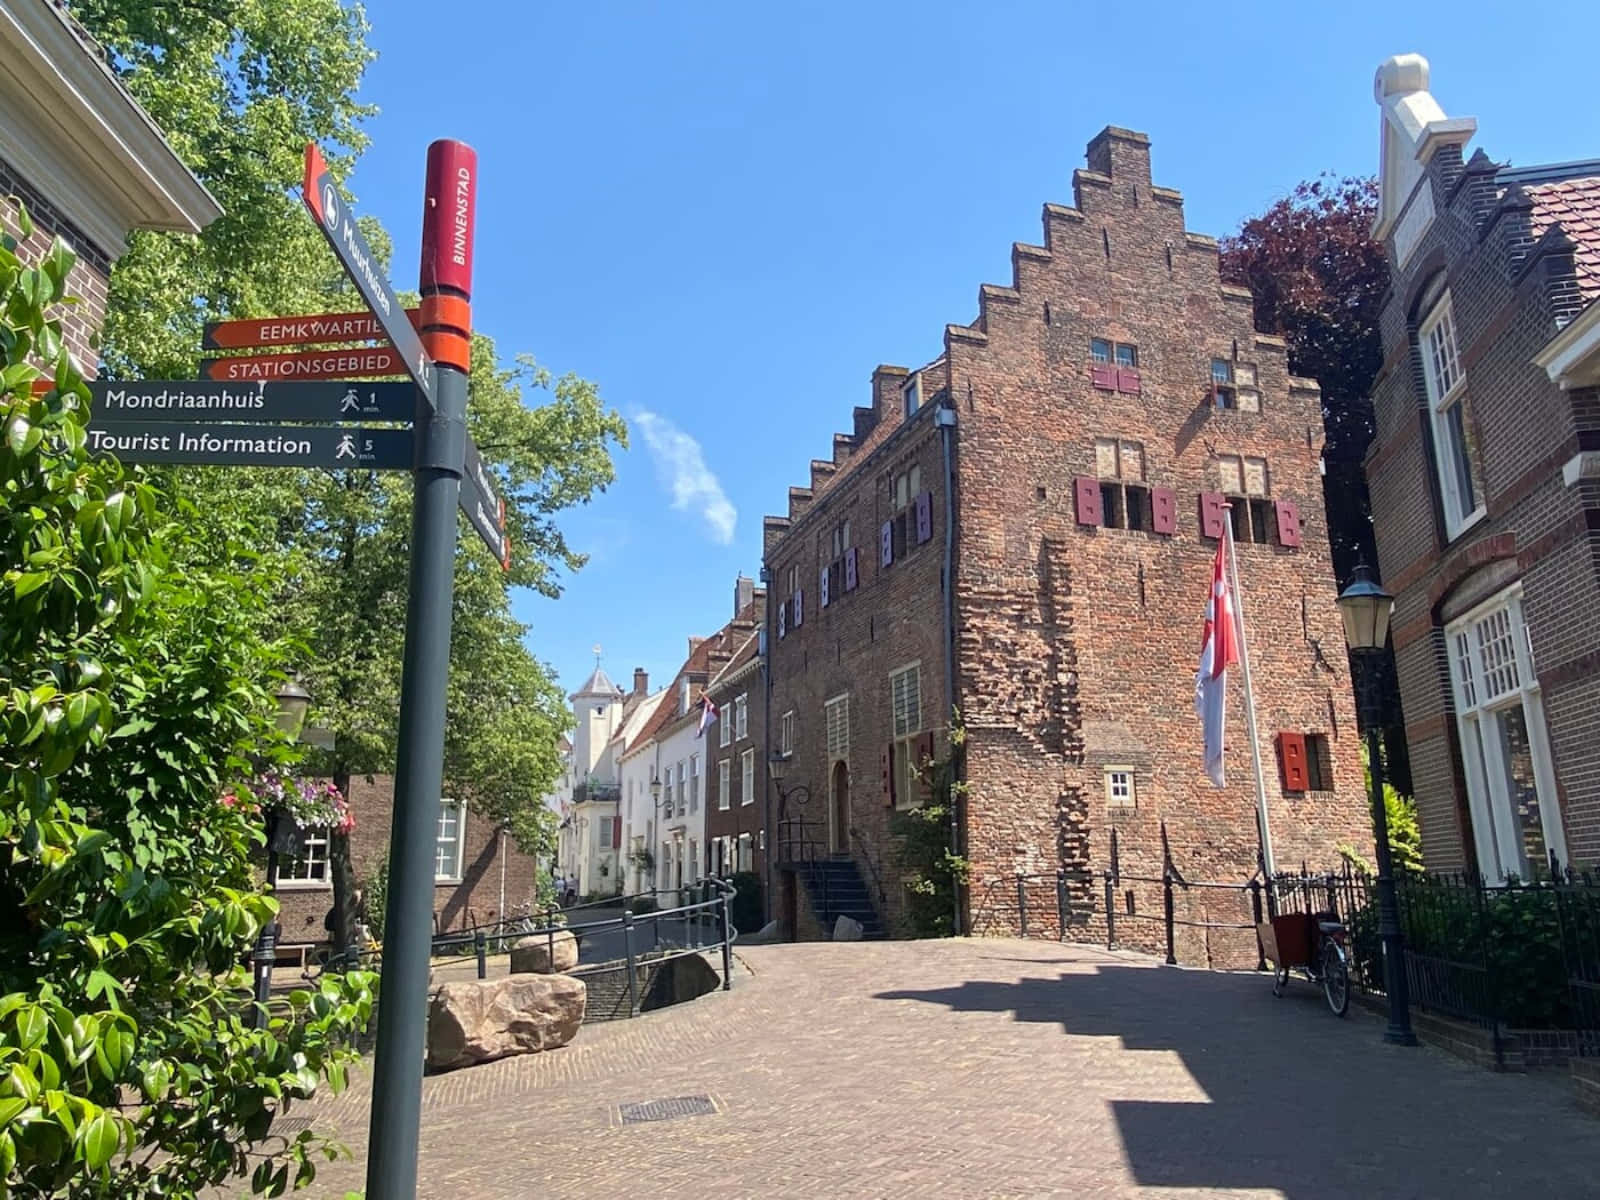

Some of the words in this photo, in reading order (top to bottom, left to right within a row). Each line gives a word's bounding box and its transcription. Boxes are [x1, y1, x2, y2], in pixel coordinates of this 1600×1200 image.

[452, 167, 470, 266] BINNENSTAD
[343, 218, 391, 317] Muurhuizen
[260, 319, 382, 340] EEMKWARTIE
[228, 355, 391, 379] STATIONSGEBIED
[105, 390, 264, 409] Mondriaanhuis
[369, 392, 376, 404] 1
[89, 430, 170, 451] Tourist
[178, 432, 312, 455] Information
[364, 439, 374, 451] 5
